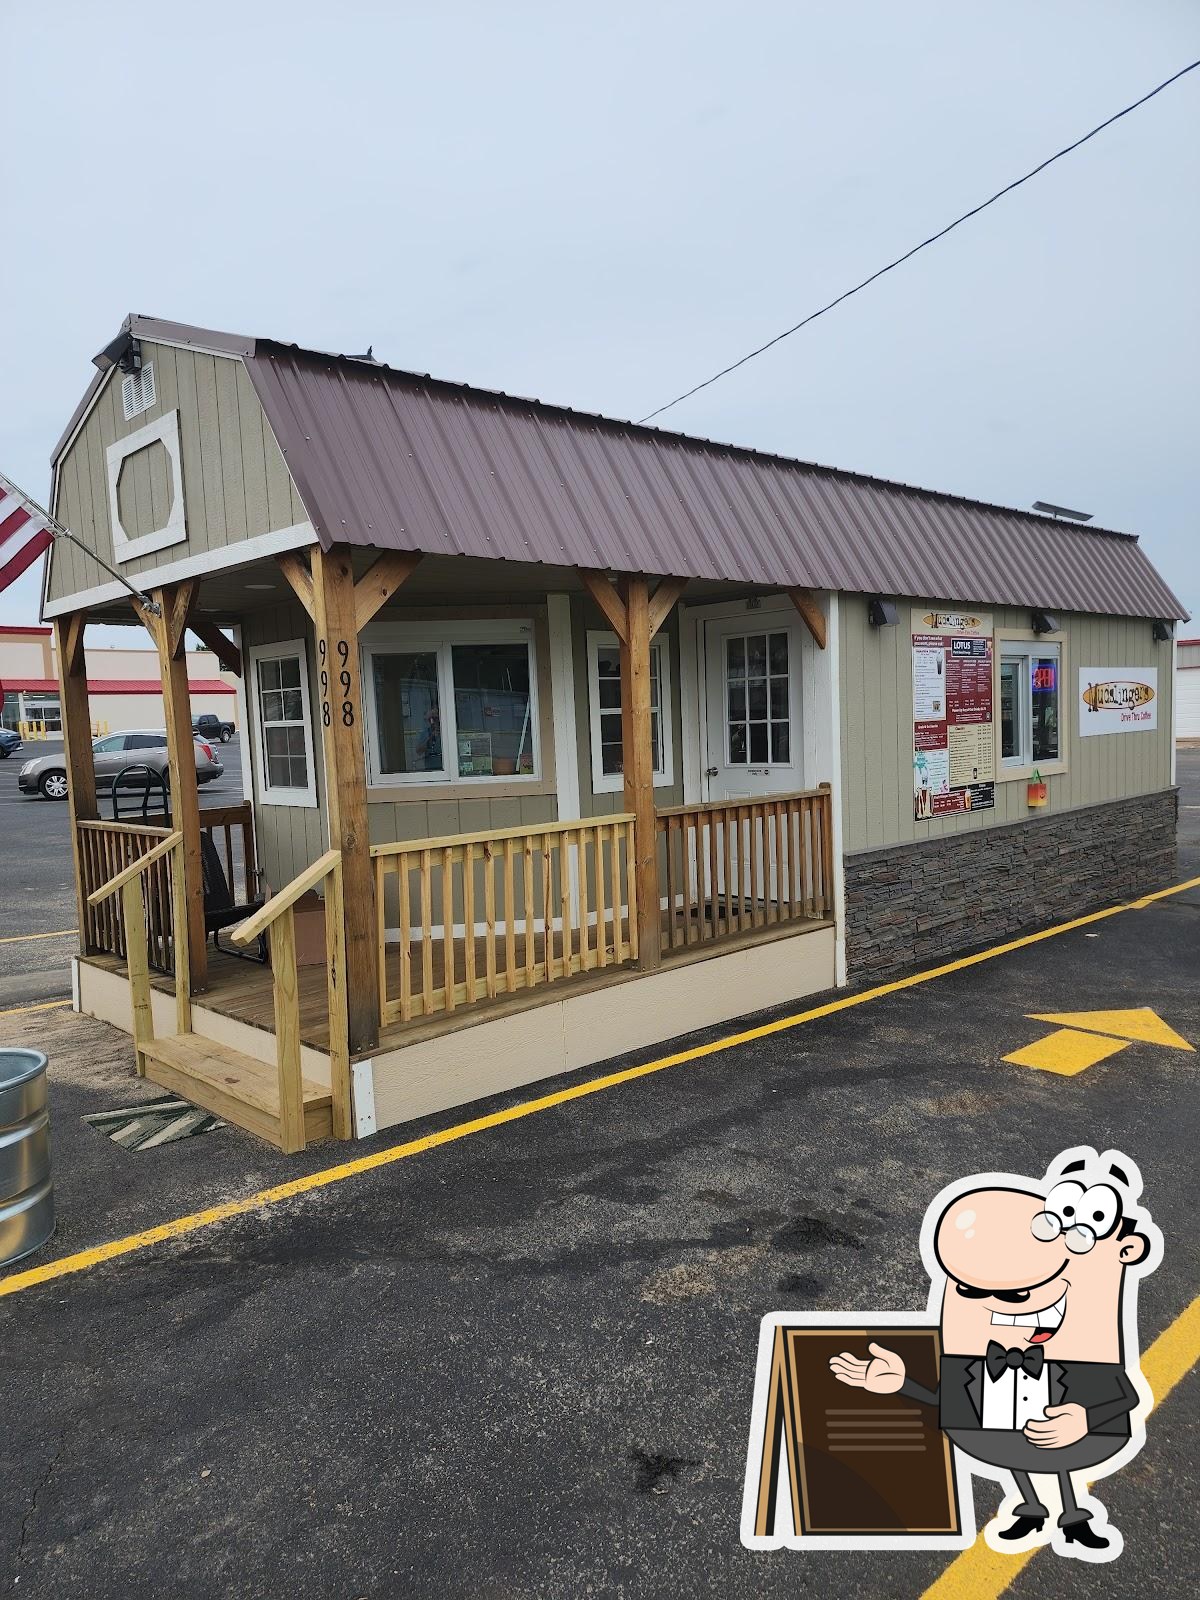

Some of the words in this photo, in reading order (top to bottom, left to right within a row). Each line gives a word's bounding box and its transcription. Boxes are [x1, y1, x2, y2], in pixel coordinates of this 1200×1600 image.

[953, 641, 971, 649] LOTUS
[337, 640, 355, 727] 998
[1033, 668, 1054, 689] OPEN
[1087, 682, 1150, 712] Mudslingers
[1121, 713, 1132, 722] Drive
[1132, 712, 1140, 721] Thru
[1140, 711, 1152, 721] Coffee
